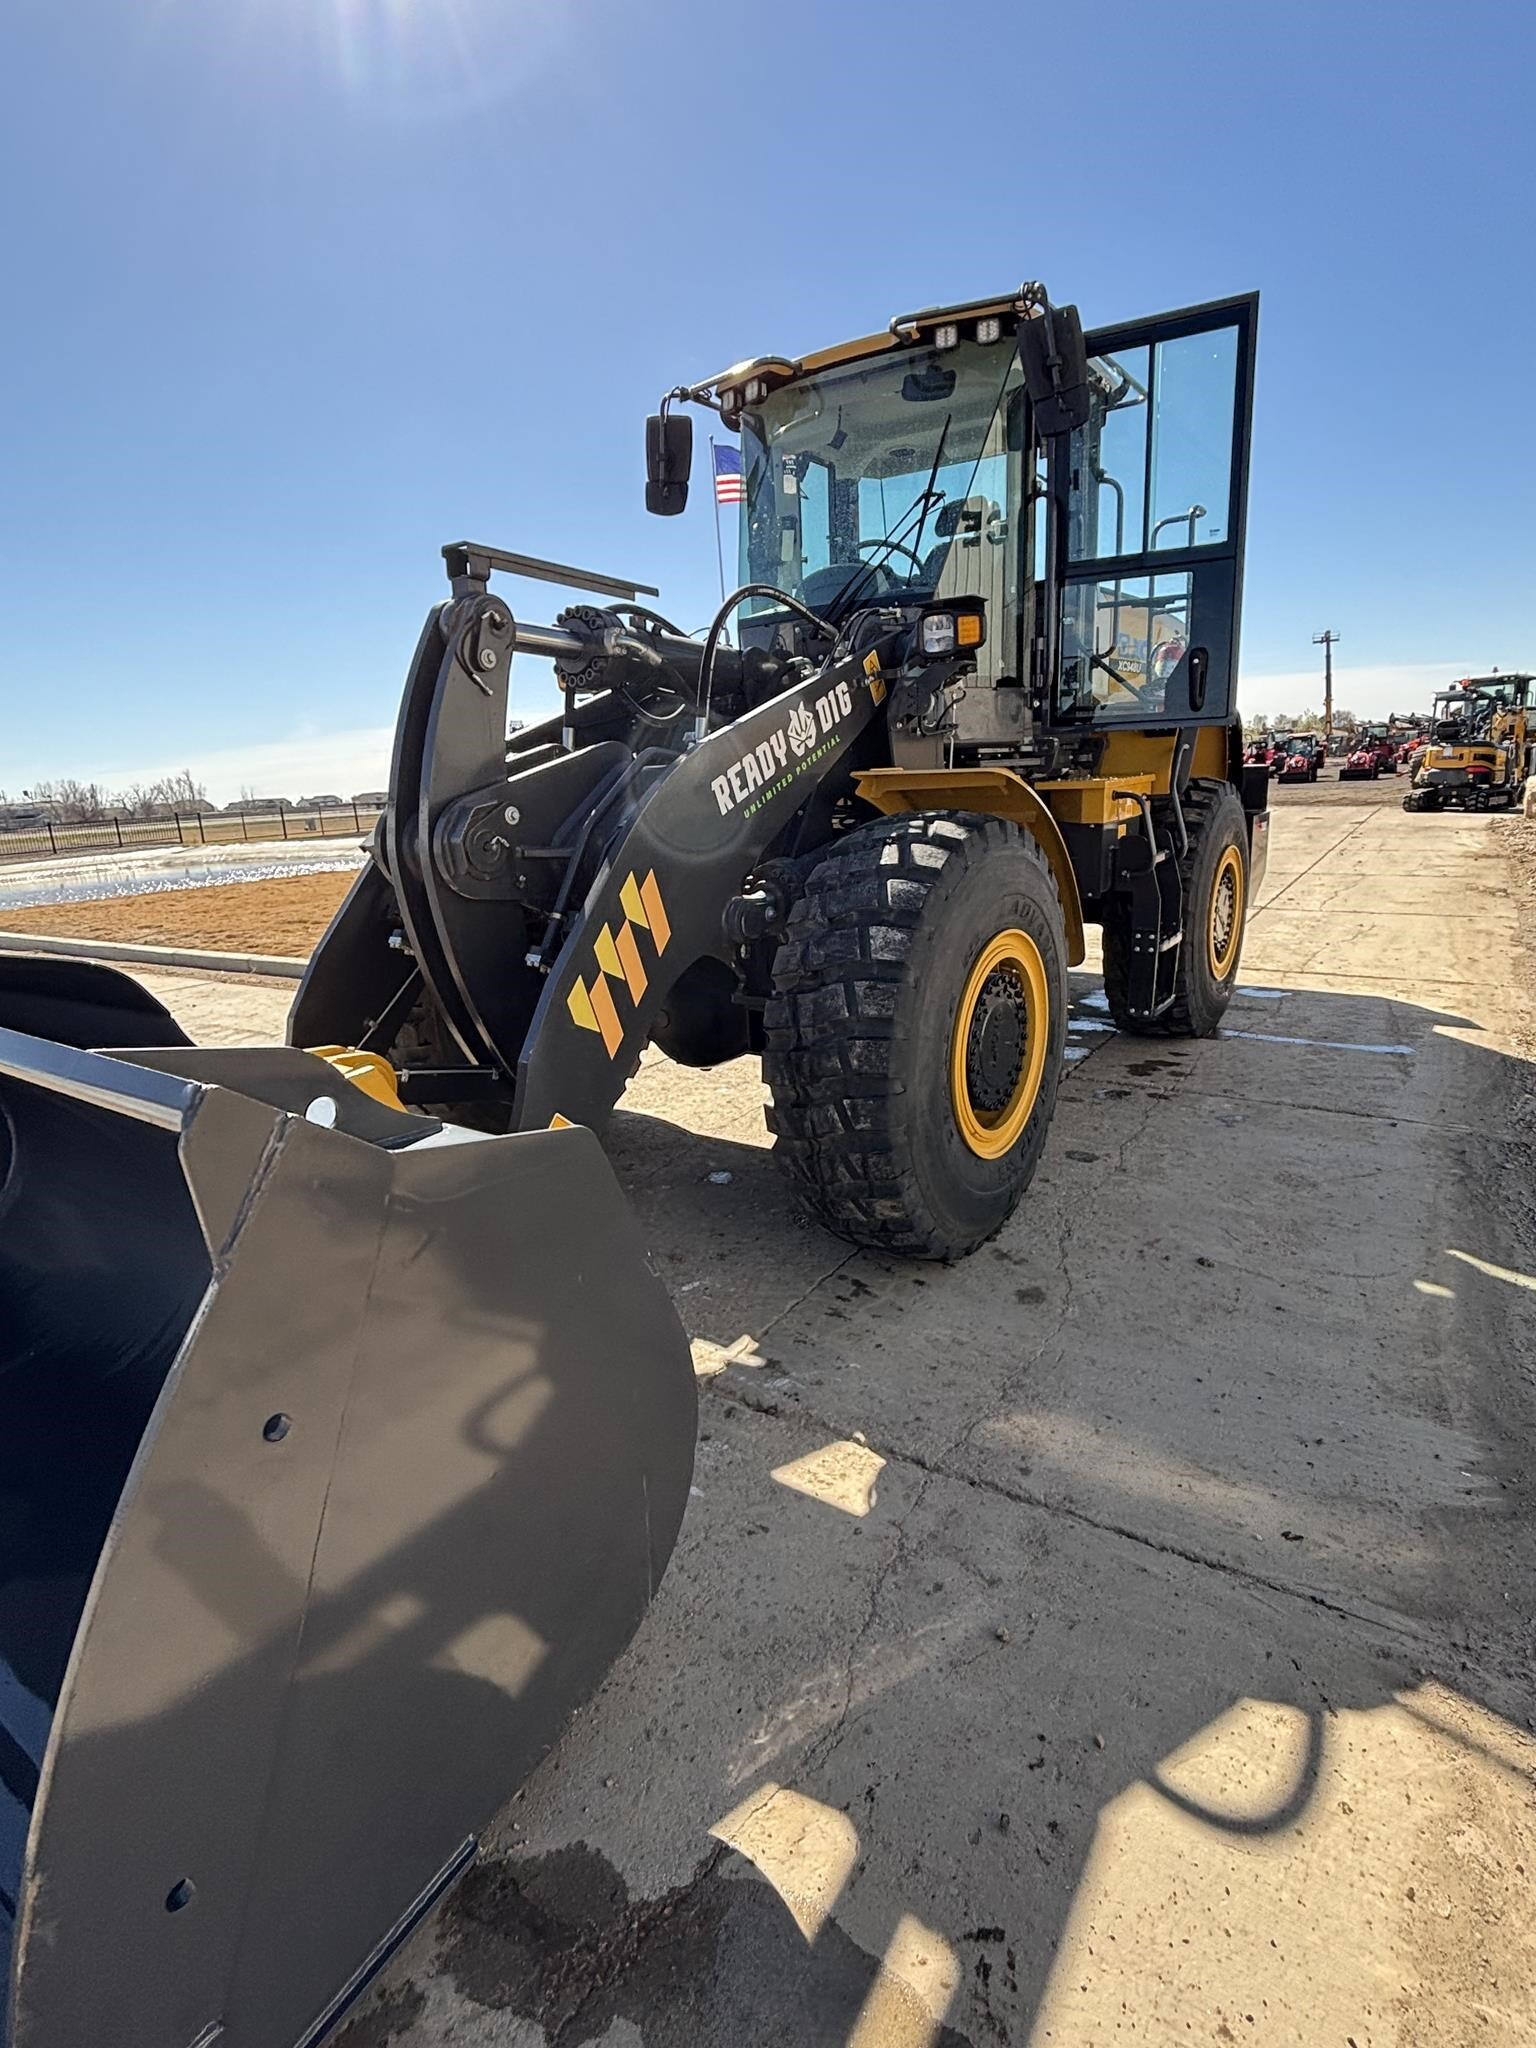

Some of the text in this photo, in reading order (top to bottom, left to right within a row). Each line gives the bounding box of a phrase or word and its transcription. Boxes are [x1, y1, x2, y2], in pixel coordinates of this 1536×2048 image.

[711, 681, 852, 816] READY DIG
[743, 735, 841, 819] UNLIMITED POTENTIAL
